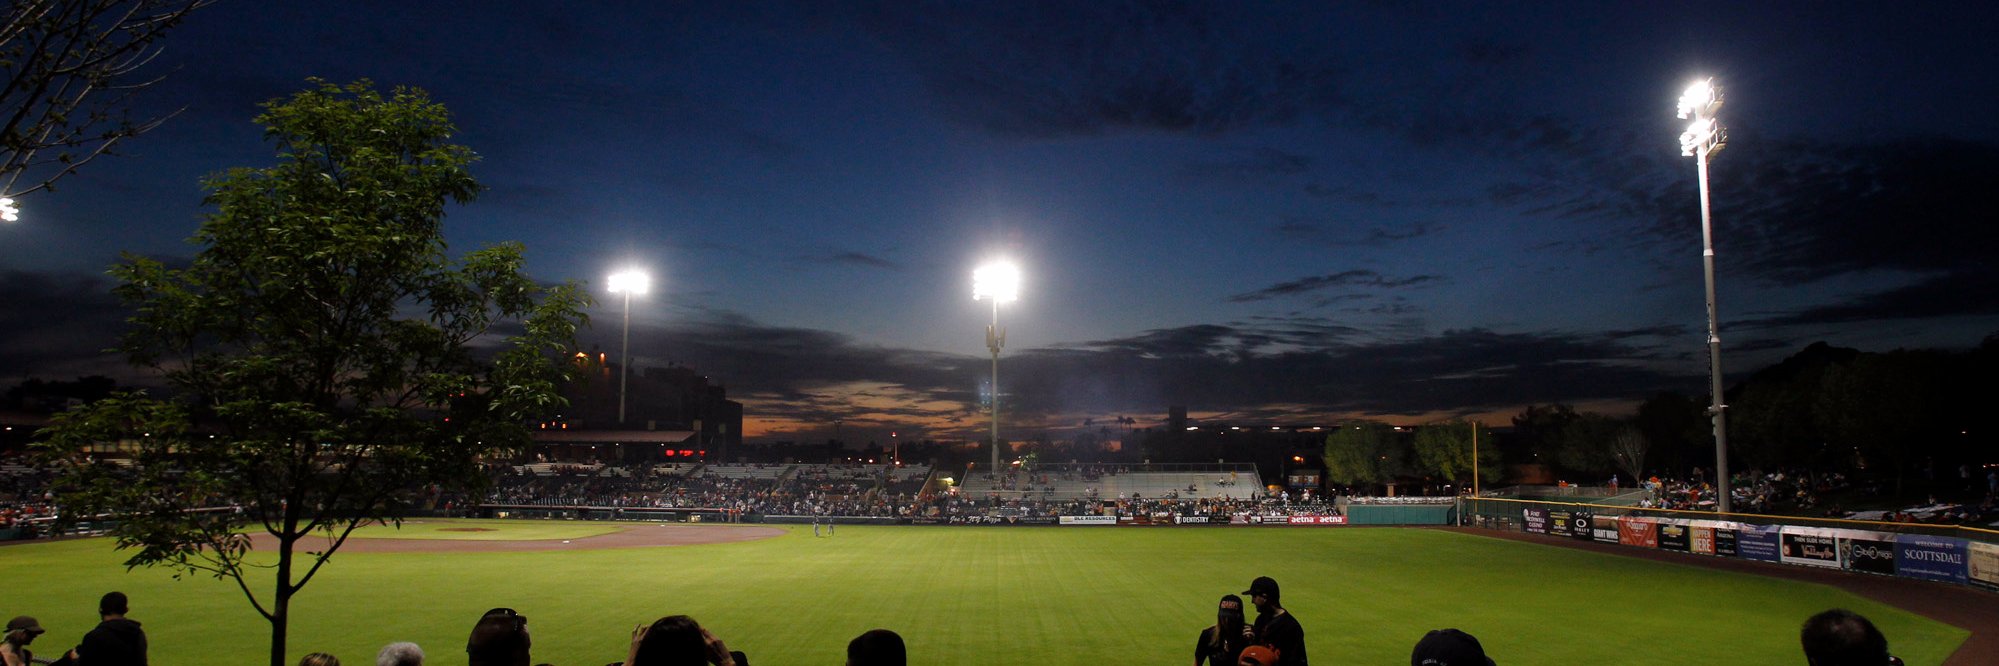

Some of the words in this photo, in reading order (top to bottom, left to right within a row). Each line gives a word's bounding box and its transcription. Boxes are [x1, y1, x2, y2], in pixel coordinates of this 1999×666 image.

[949, 515, 966, 524] Joe's
[967, 515, 981, 523] NY
[983, 515, 1002, 524] Pizza
[1693, 538, 1712, 552] HERE
[1915, 540, 1944, 549] WELCOME
[1904, 548, 1962, 565] SCOTTSDALE
